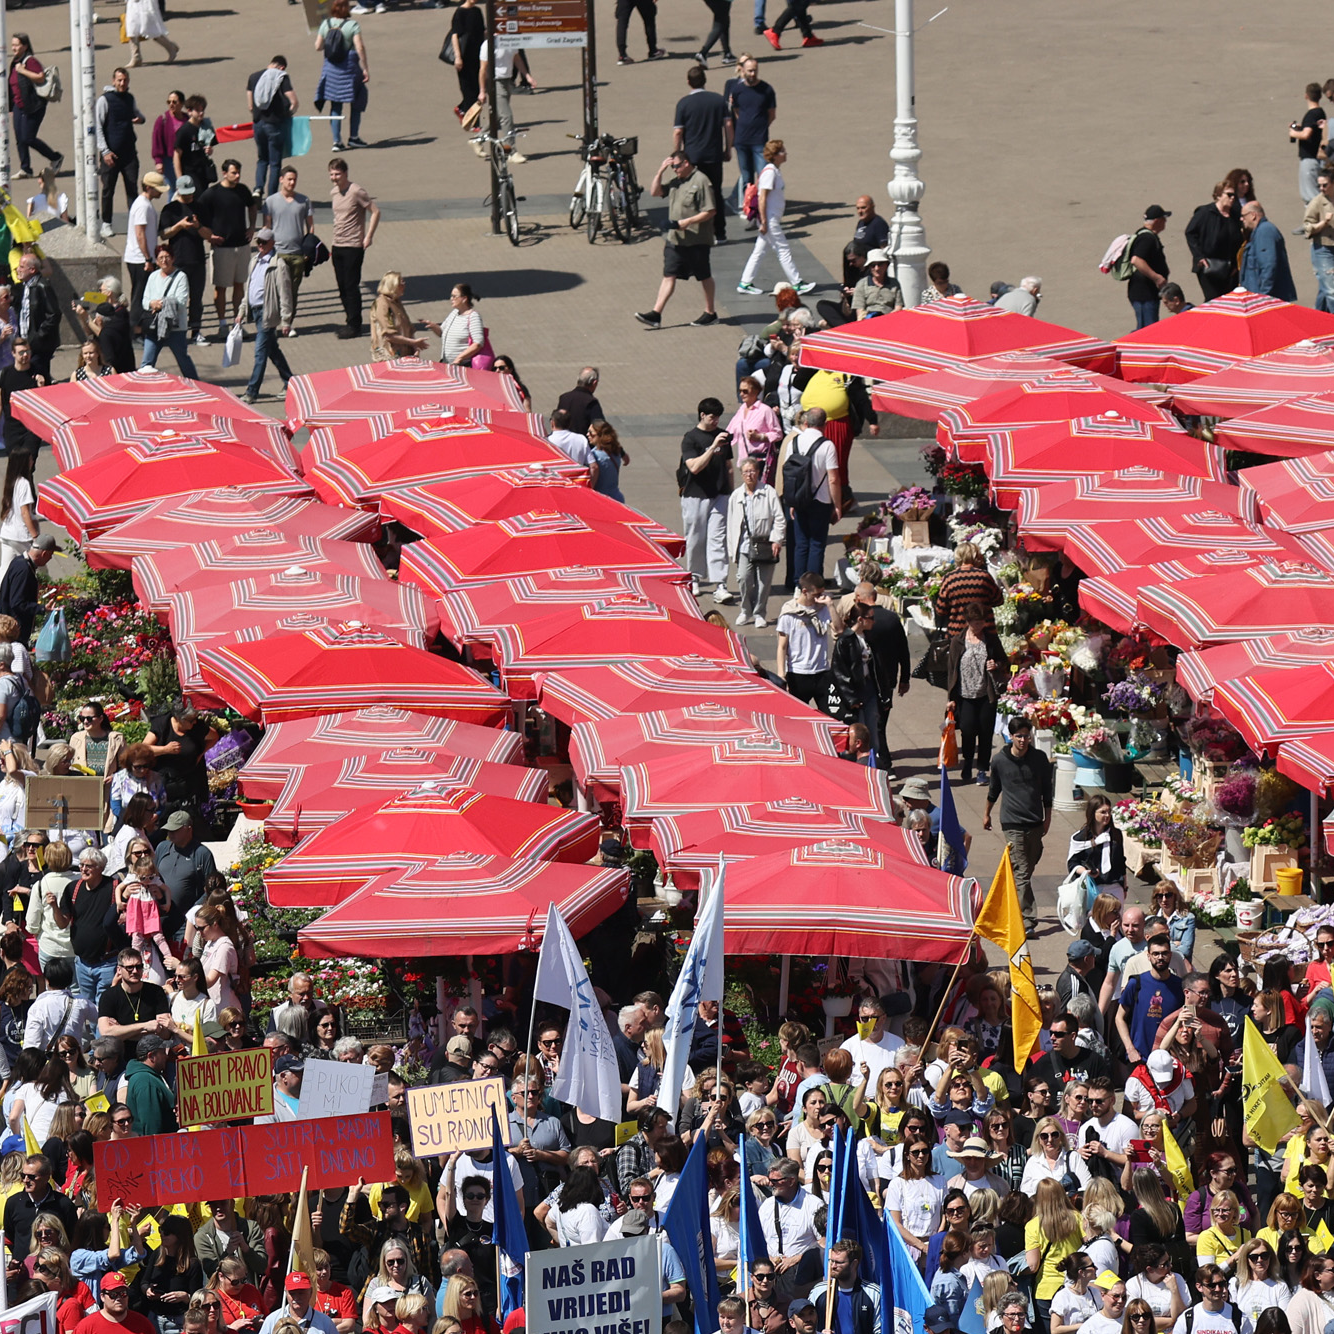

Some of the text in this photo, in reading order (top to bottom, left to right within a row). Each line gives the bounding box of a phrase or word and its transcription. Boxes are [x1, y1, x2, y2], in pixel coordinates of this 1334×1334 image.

[181, 1054, 267, 1091] NEMAM PRAVO
[317, 1071, 360, 1096] PUKO
[183, 1086, 267, 1121] NA BOLOVANJE
[425, 1082, 505, 1118] UMJETNICI
[103, 1116, 381, 1172] OD JUTRA DO RADIM
[419, 1124, 443, 1147] SU
[149, 1165, 205, 1198] PREKO
[221, 1160, 249, 1187] 12
[265, 1151, 308, 1180] SATI
[321, 1146, 376, 1176] DNEVNO
[543, 1256, 635, 1290] NAŠ RAD
[548, 1290, 631, 1321] VRIJEDI
